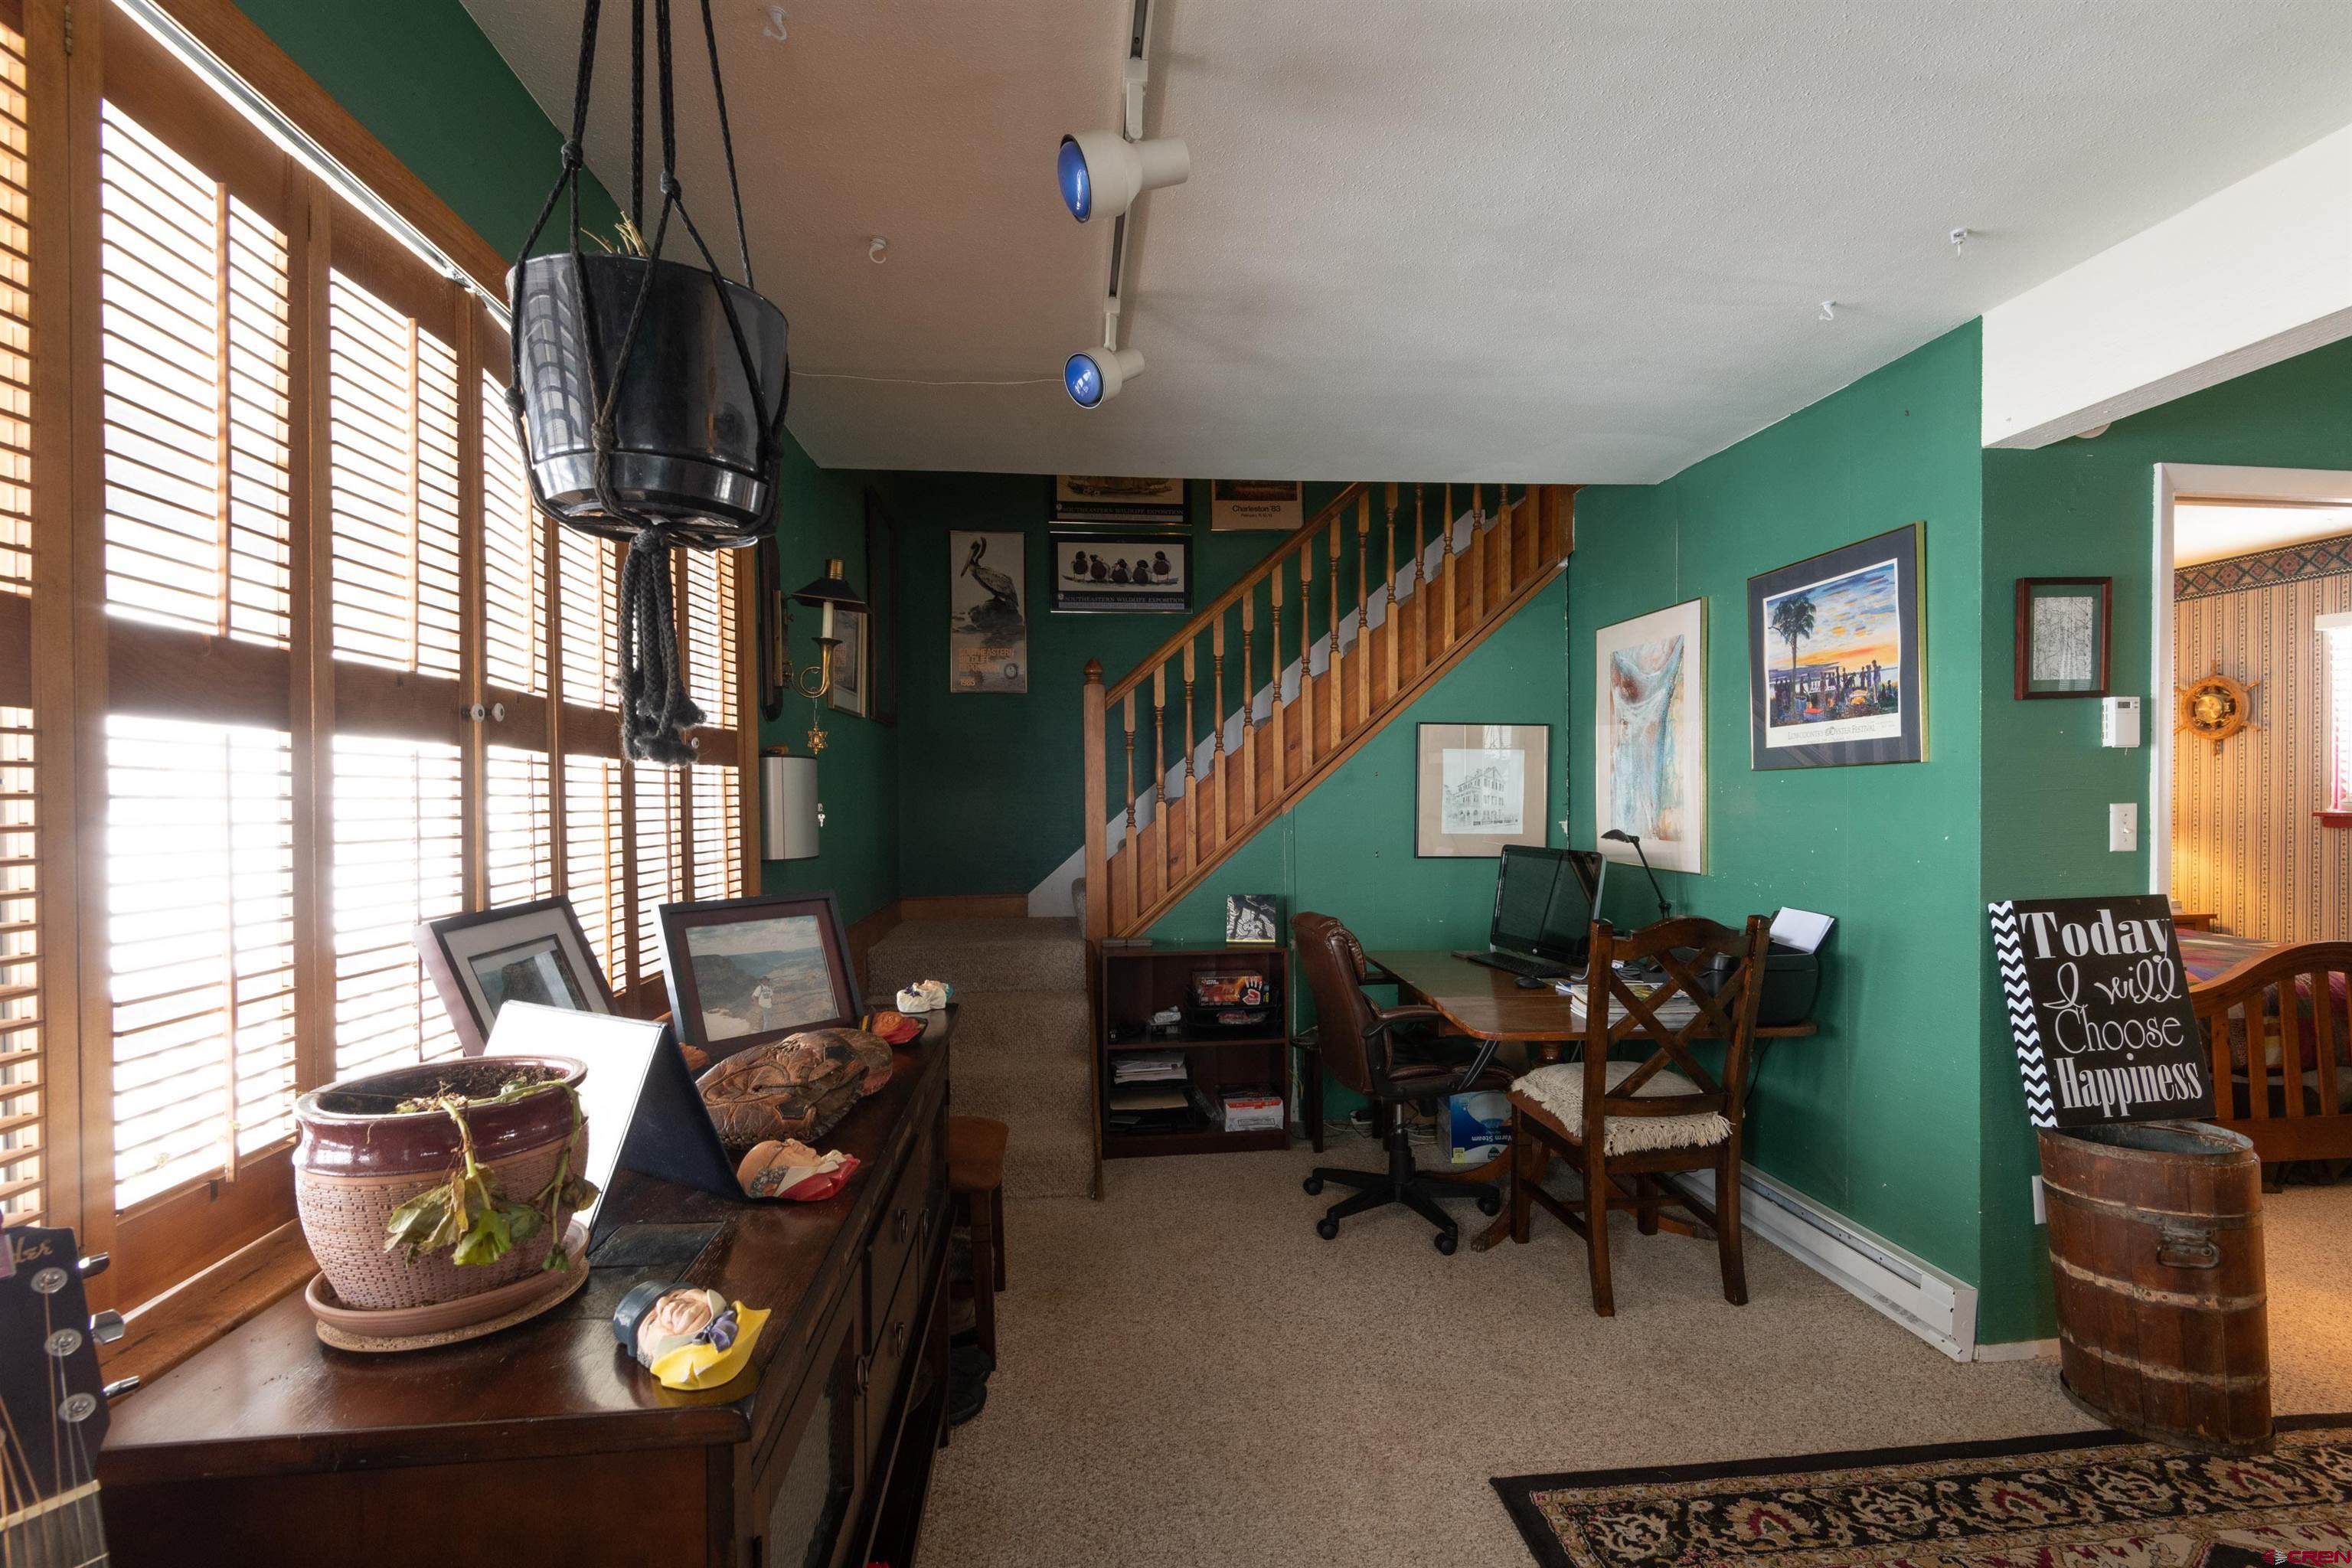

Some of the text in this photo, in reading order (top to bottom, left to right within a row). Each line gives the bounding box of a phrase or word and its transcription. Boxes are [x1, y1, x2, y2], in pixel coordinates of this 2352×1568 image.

[2019, 909, 2171, 963] Today
[2043, 958, 2181, 1009] I will
[2054, 1006, 2184, 1054] Choose
[2053, 1053, 2203, 1118] Happiness
